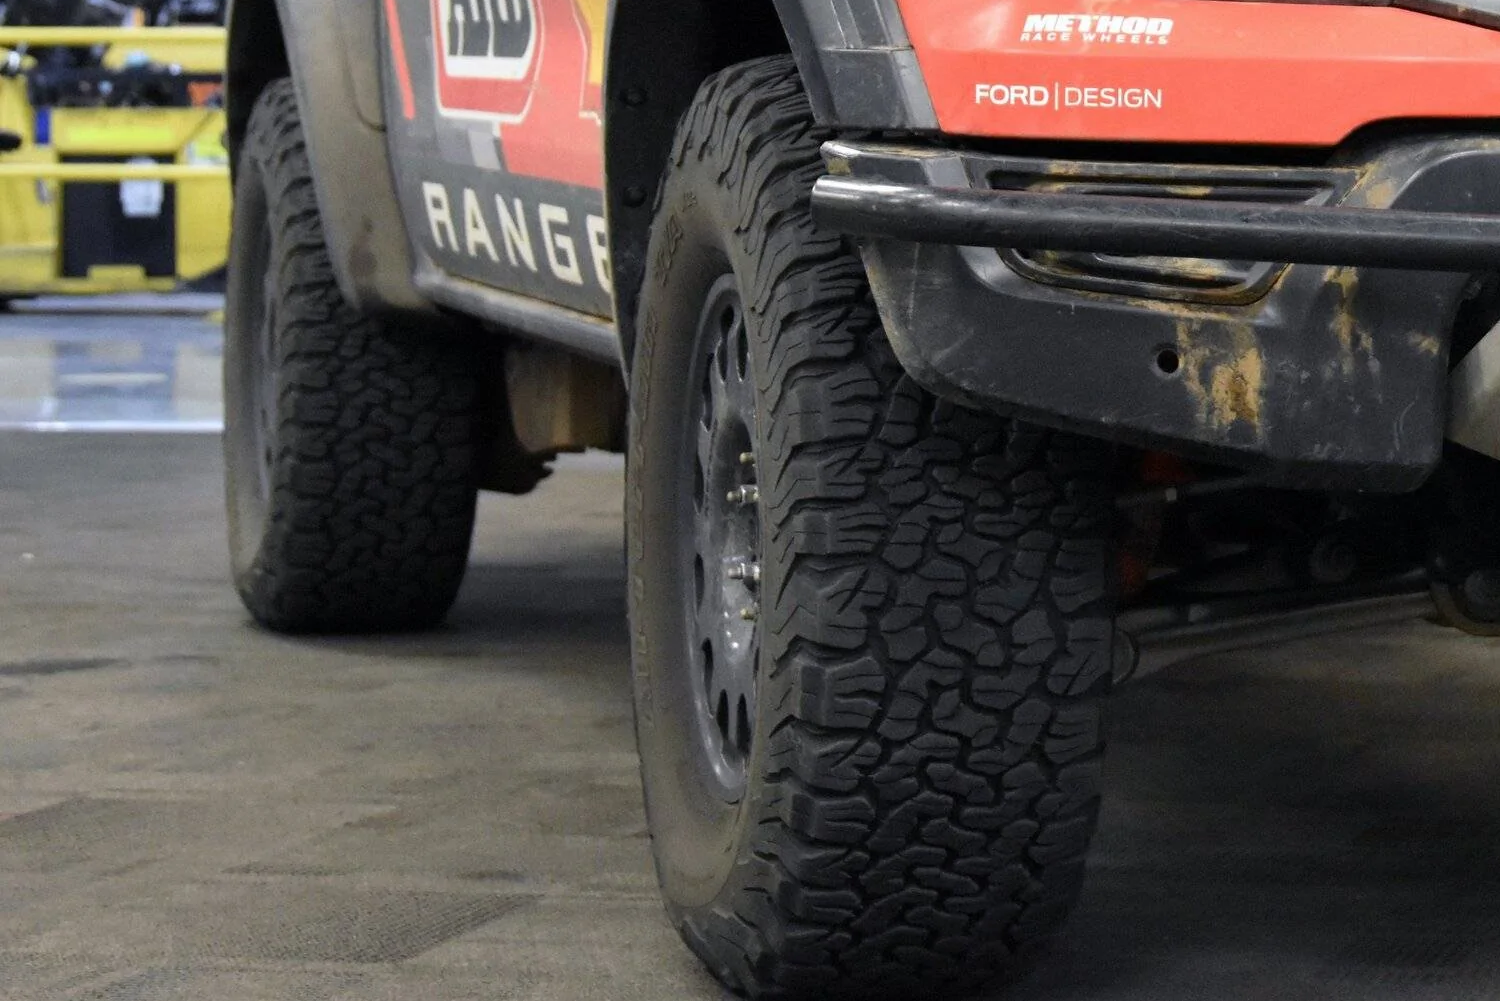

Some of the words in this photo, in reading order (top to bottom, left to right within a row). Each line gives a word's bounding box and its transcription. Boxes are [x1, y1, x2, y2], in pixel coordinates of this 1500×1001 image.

[1023, 13, 1174, 36] METHOD
[1020, 32, 1071, 42] RACE
[1083, 34, 1169, 45] WHEELS
[975, 83, 1049, 106] FORD
[1064, 87, 1163, 109] DESIGN
